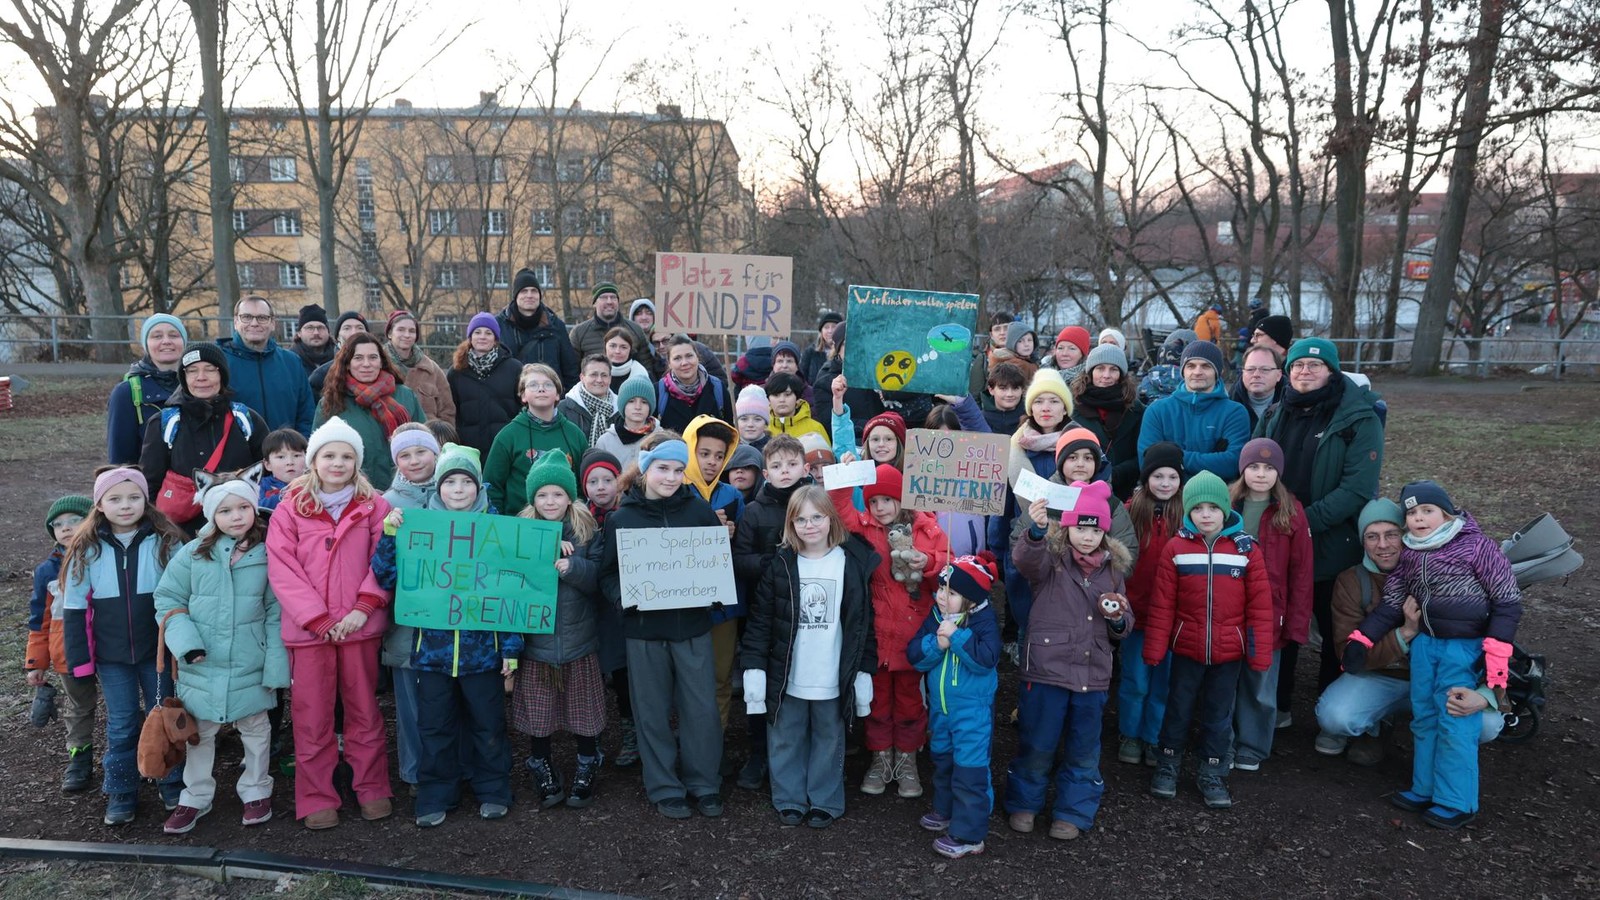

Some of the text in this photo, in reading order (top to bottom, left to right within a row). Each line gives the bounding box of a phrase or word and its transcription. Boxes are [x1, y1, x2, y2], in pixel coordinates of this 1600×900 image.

[661, 254, 783, 291] Platz für
[663, 291, 781, 332] KINDER
[915, 296, 944, 307] wollen
[945, 299, 977, 312] spielen
[915, 435, 997, 461] WO soll
[920, 459, 1002, 480] ich HIER
[619, 529, 727, 555] Ein Spielplatz
[401, 558, 489, 592] UNSER
[645, 559, 682, 572] mein
[448, 594, 552, 629] BRENNER
